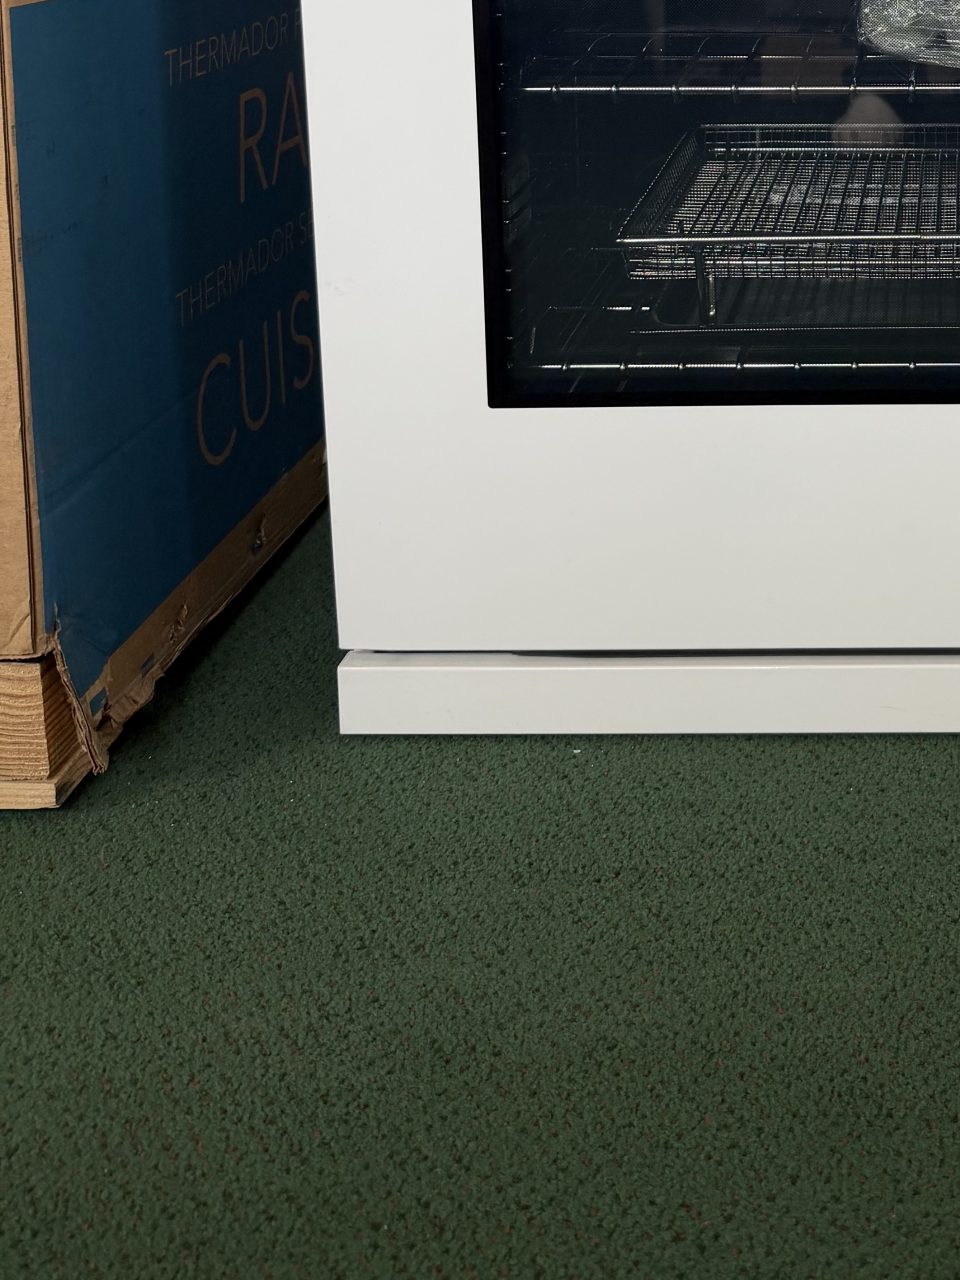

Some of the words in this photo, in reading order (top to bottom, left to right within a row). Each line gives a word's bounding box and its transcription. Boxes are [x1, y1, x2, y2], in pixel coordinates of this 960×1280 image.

[164, 12, 288, 88] THERMADOR
[239, 72, 309, 203] RA
[176, 221, 294, 328] THERMADOR
[196, 289, 315, 466] CUIS
